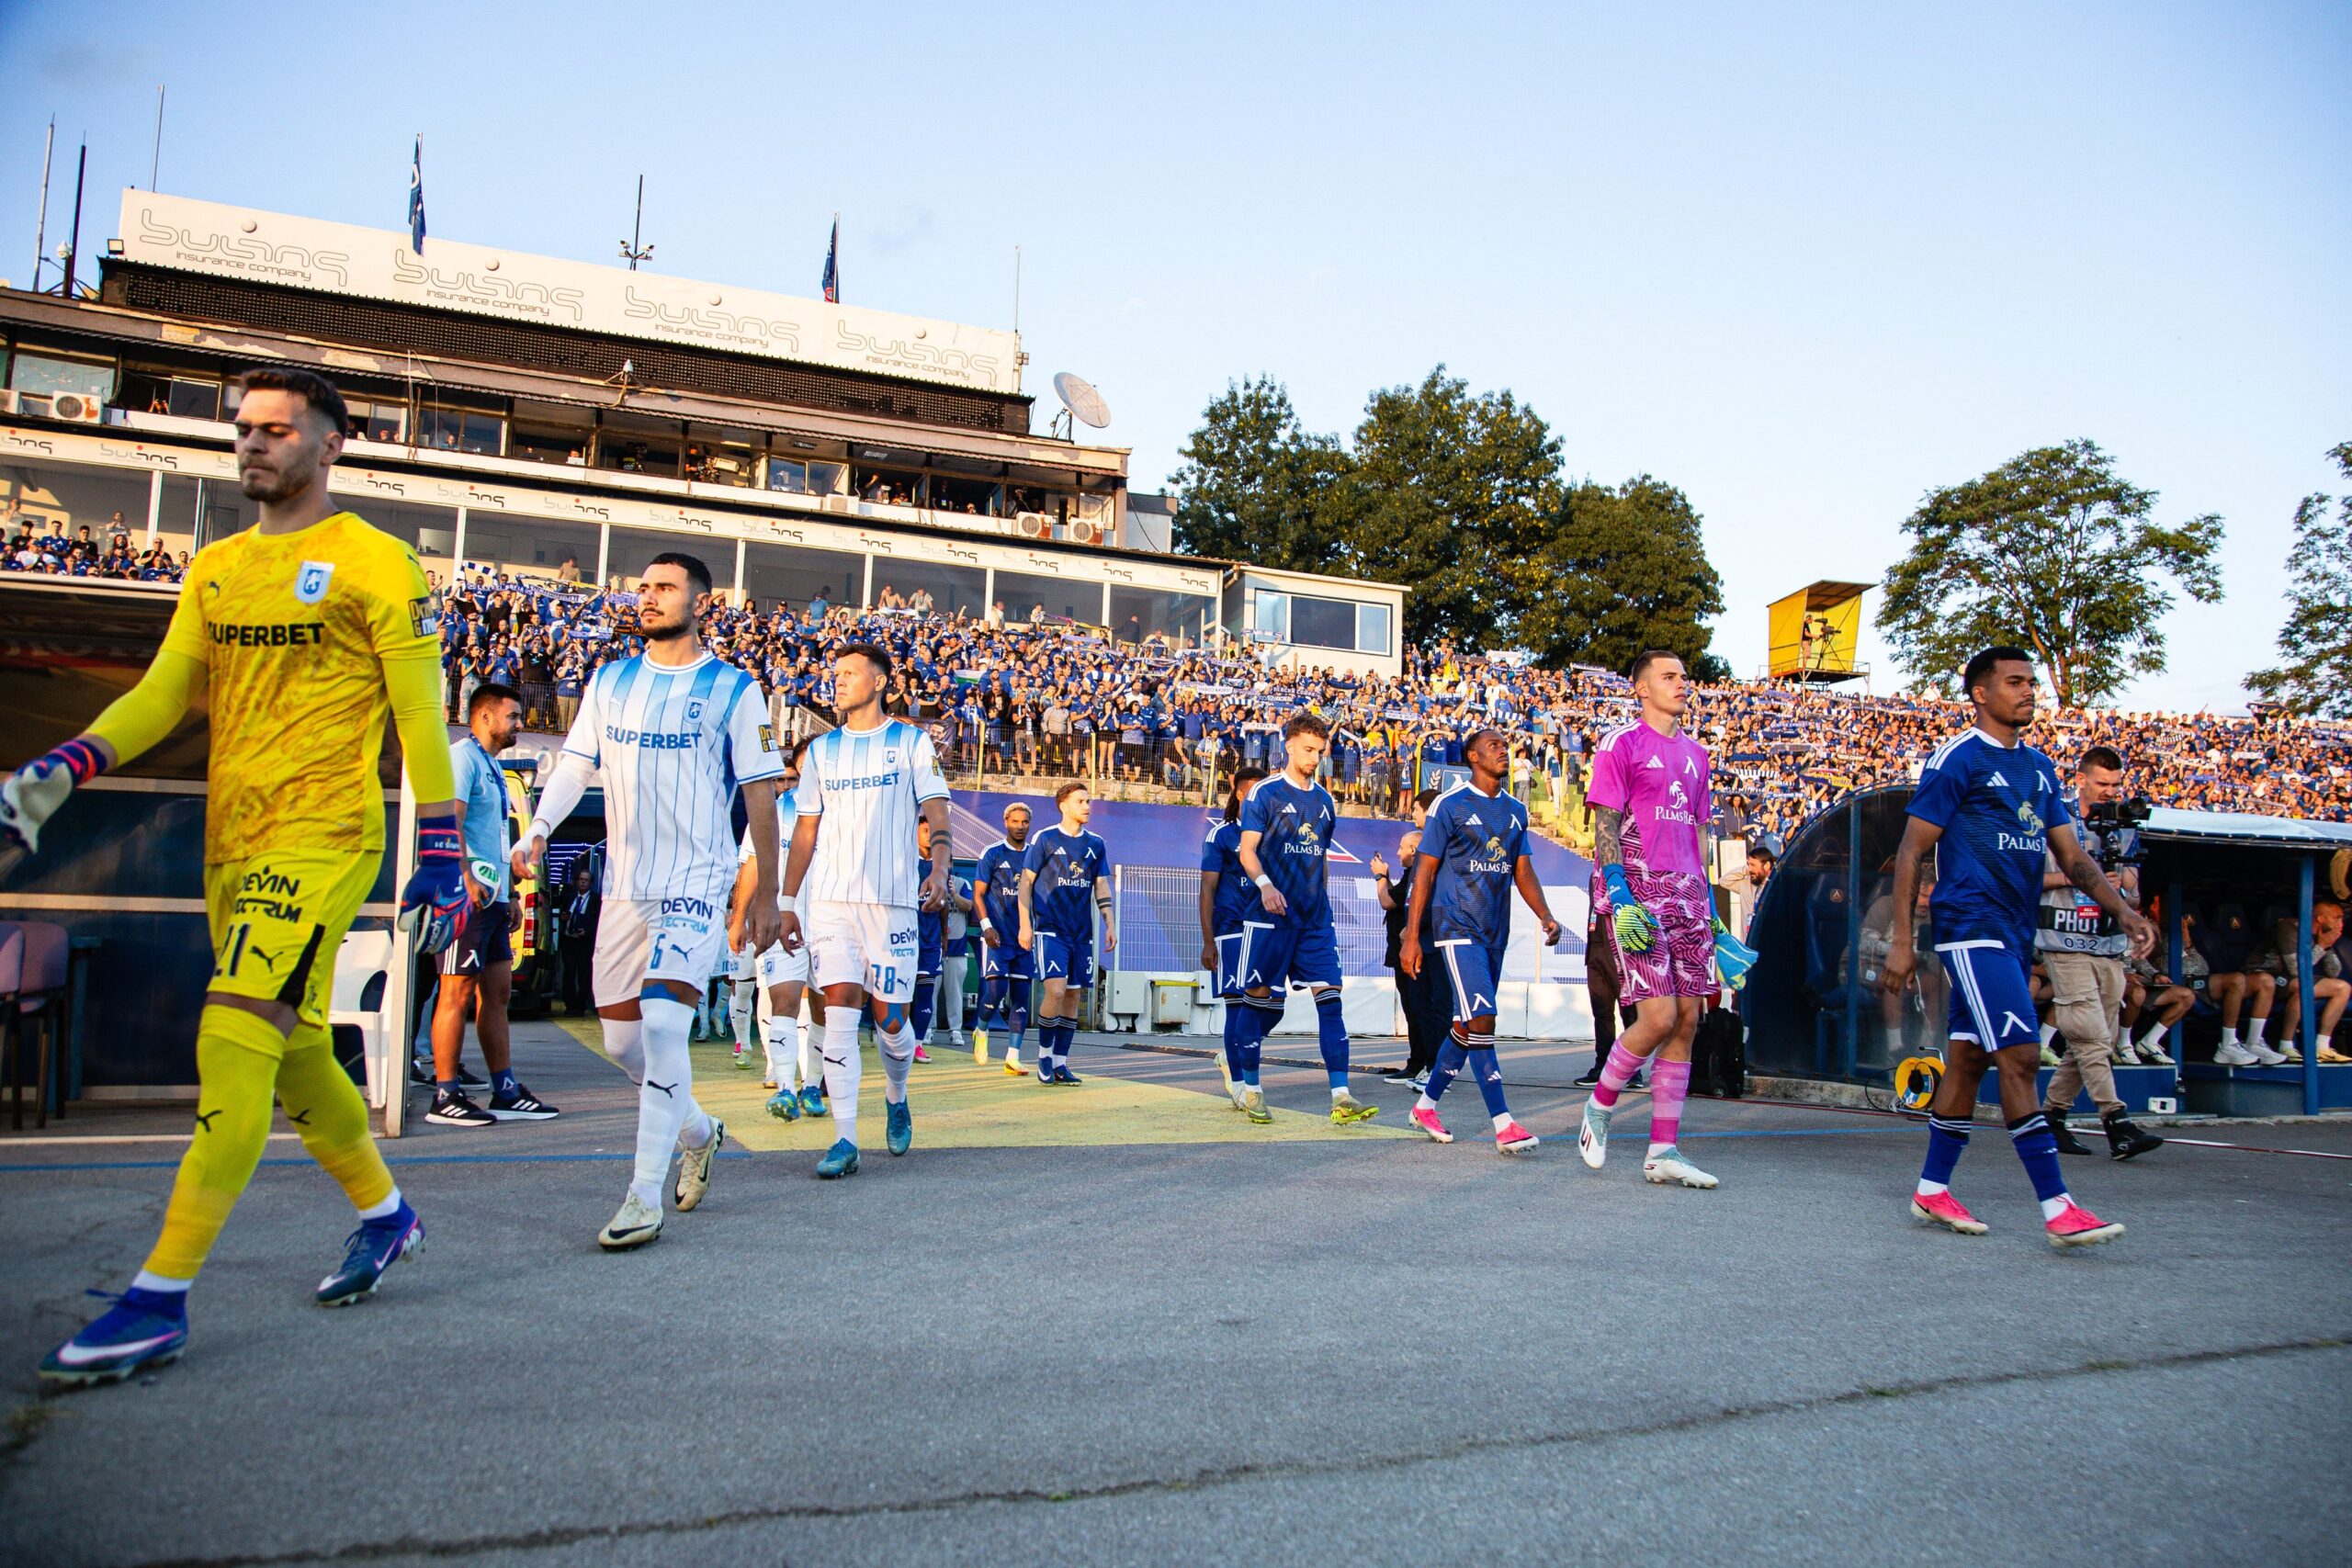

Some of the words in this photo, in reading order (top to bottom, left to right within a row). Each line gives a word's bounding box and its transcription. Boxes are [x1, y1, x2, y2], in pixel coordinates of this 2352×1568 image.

[175, 250, 245, 269] insurance
[249, 262, 311, 282] company
[426, 288, 490, 305] insurance
[492, 299, 549, 316] company
[605, 725, 702, 750] SUPERBET
[825, 772, 900, 791] SUPERBET
[661, 897, 714, 920] DEVIN
[650, 932, 667, 970] 6
[2064, 937, 2098, 951] 032
[871, 964, 896, 995] 28
